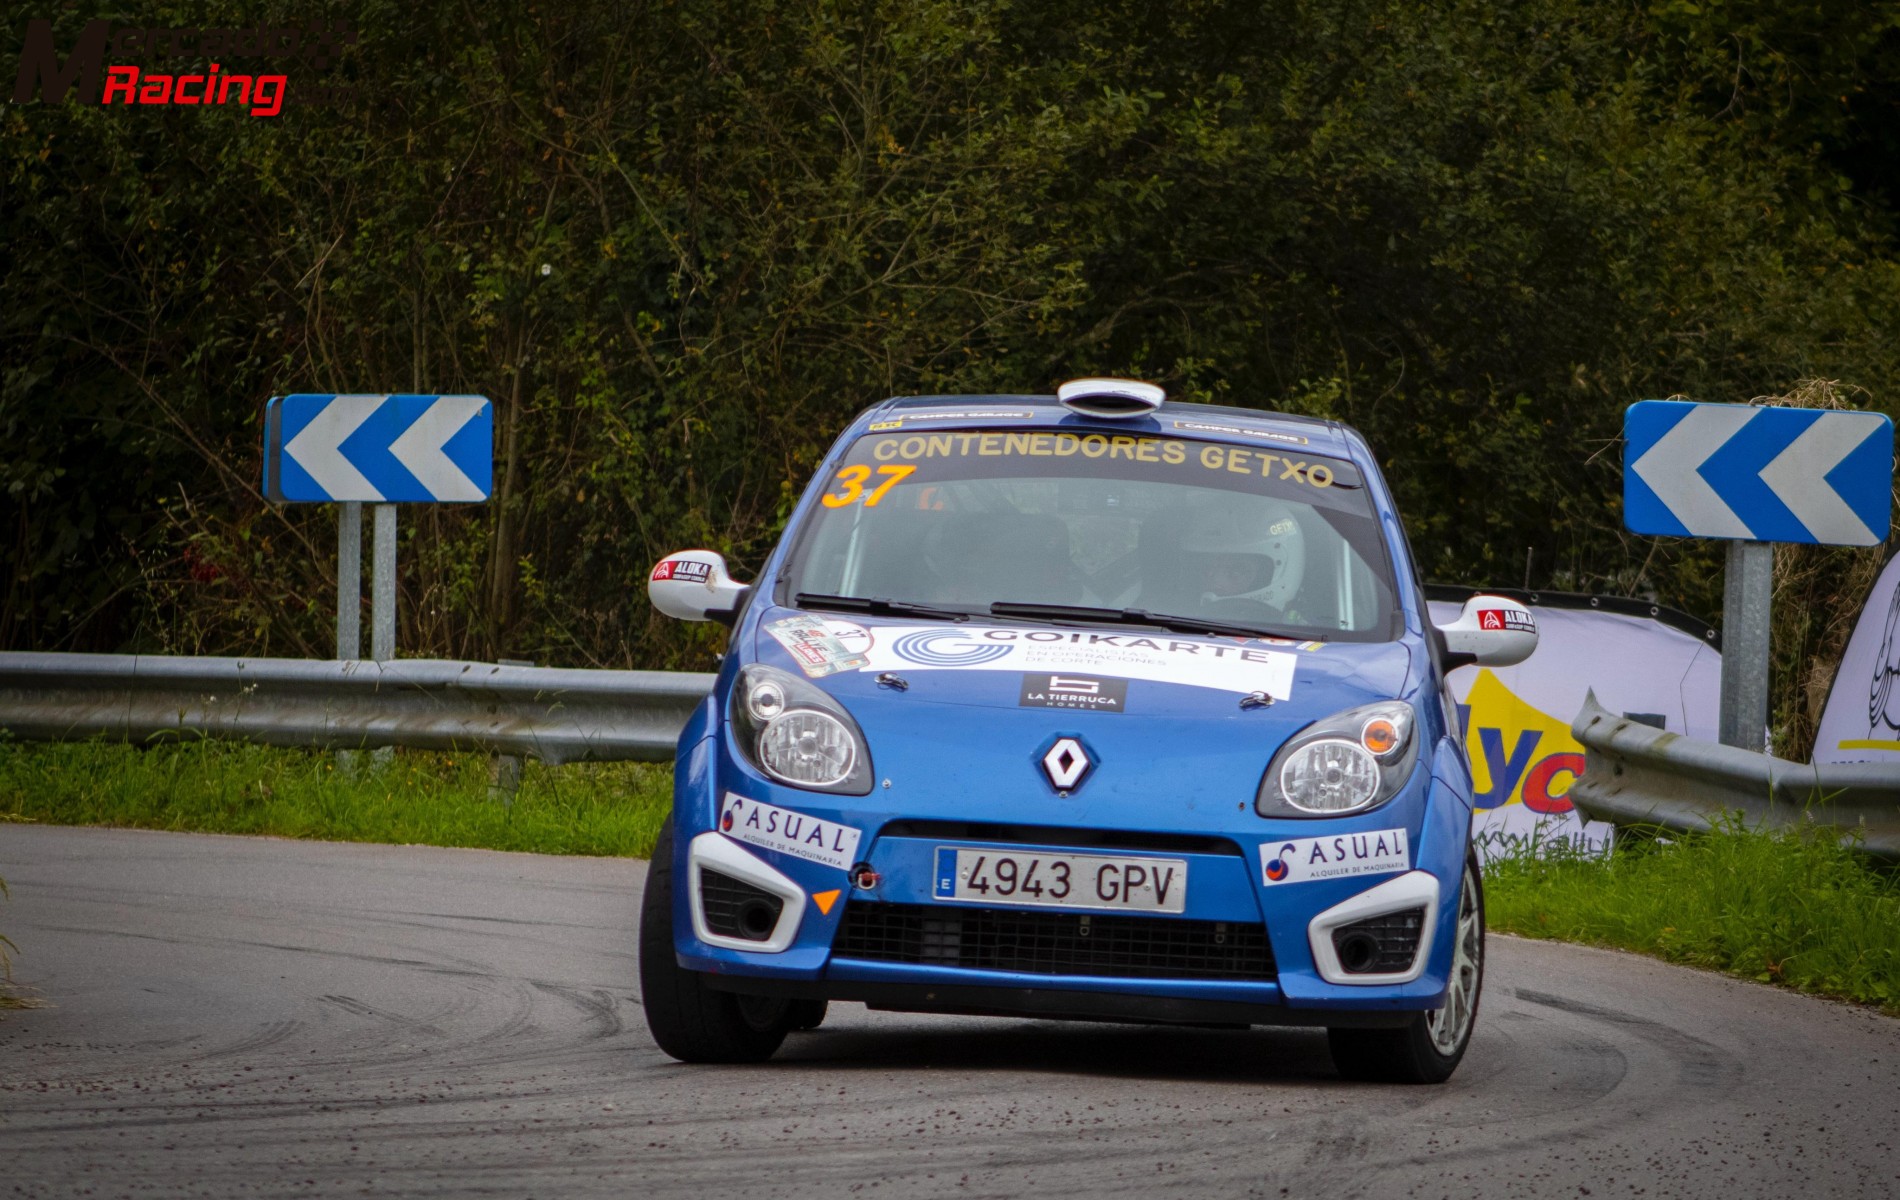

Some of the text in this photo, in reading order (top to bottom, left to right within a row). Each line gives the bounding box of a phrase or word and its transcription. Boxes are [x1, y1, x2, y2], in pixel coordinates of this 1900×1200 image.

[1184, 423, 1299, 442] CAMPER GARAGE
[873, 432, 1334, 488] CONTENEDORES GETXO
[821, 464, 918, 508] 37
[674, 561, 709, 576] ALOKA
[1504, 610, 1535, 625] ALOKA
[834, 629, 867, 639] 37
[983, 630, 1269, 664] GOIKARTE
[1028, 645, 1149, 657] ESPECIALISTAS
[1050, 657, 1104, 666] CORTE
[1051, 651, 1167, 666] OPERACIONES
[1046, 701, 1097, 709] HOMES
[1048, 693, 1117, 705] TIERRUCA
[743, 833, 842, 867] ALQUILER DE MAQUINARIA
[1309, 868, 1349, 878] ALQUILER
[1363, 862, 1404, 872] MAQUINARIA
[940, 878, 951, 890] E
[967, 856, 1174, 905] 4943 GPV
